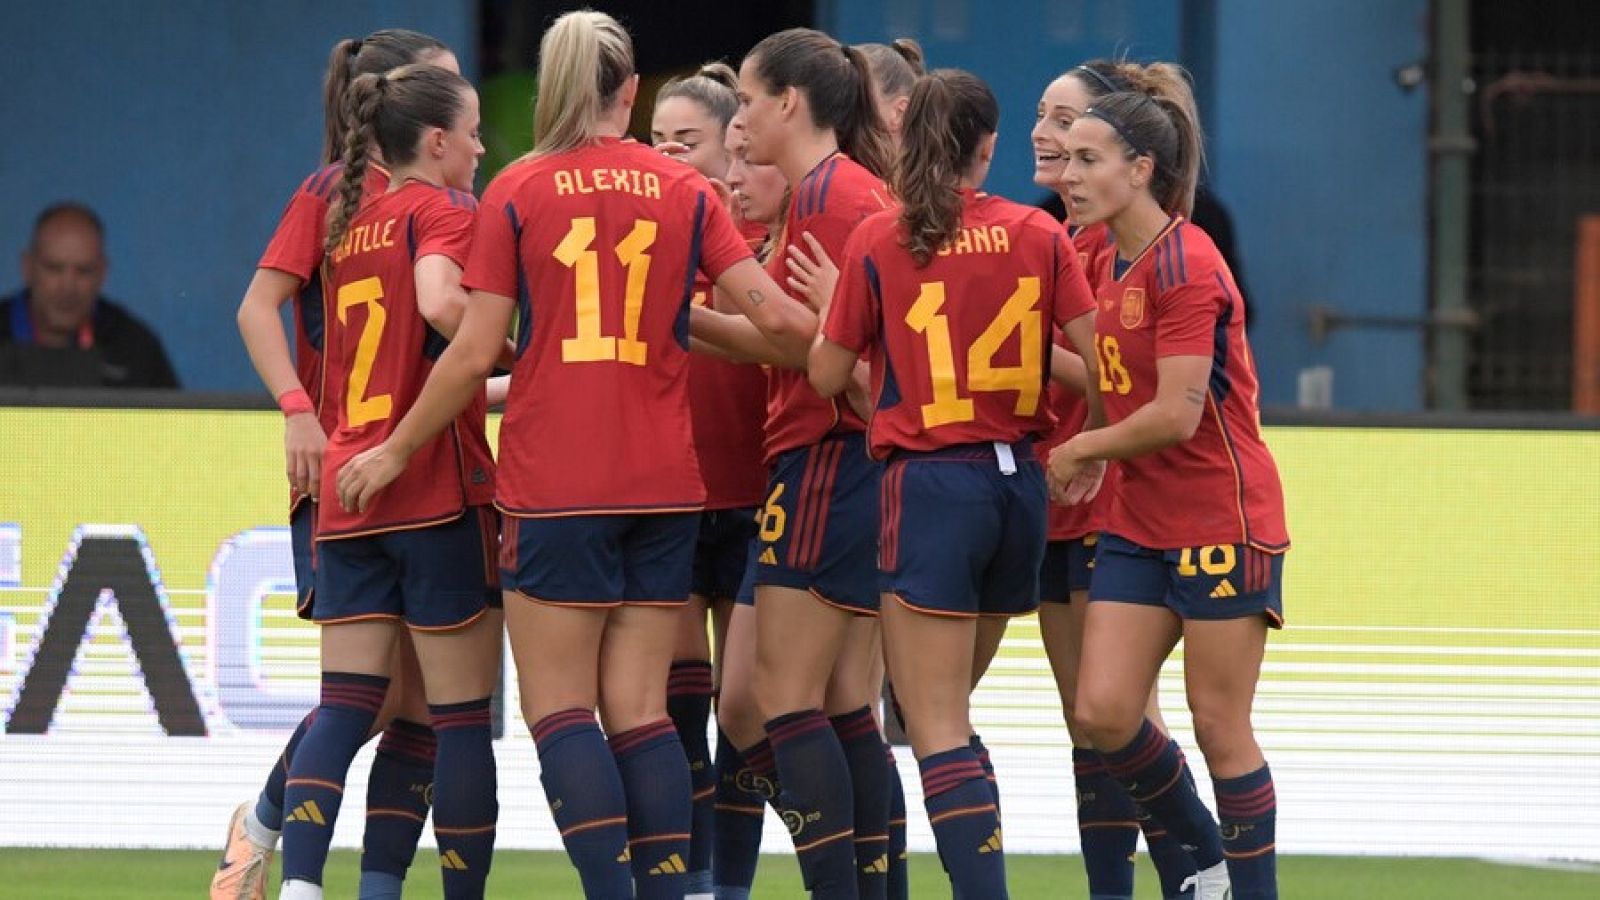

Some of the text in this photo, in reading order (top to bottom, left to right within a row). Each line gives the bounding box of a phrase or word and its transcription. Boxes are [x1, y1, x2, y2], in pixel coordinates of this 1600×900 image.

[554, 168, 661, 199] ALEXIA
[337, 275, 393, 428] 2
[552, 216, 658, 366] 11
[904, 276, 1041, 428] 14
[760, 482, 787, 542] 6
